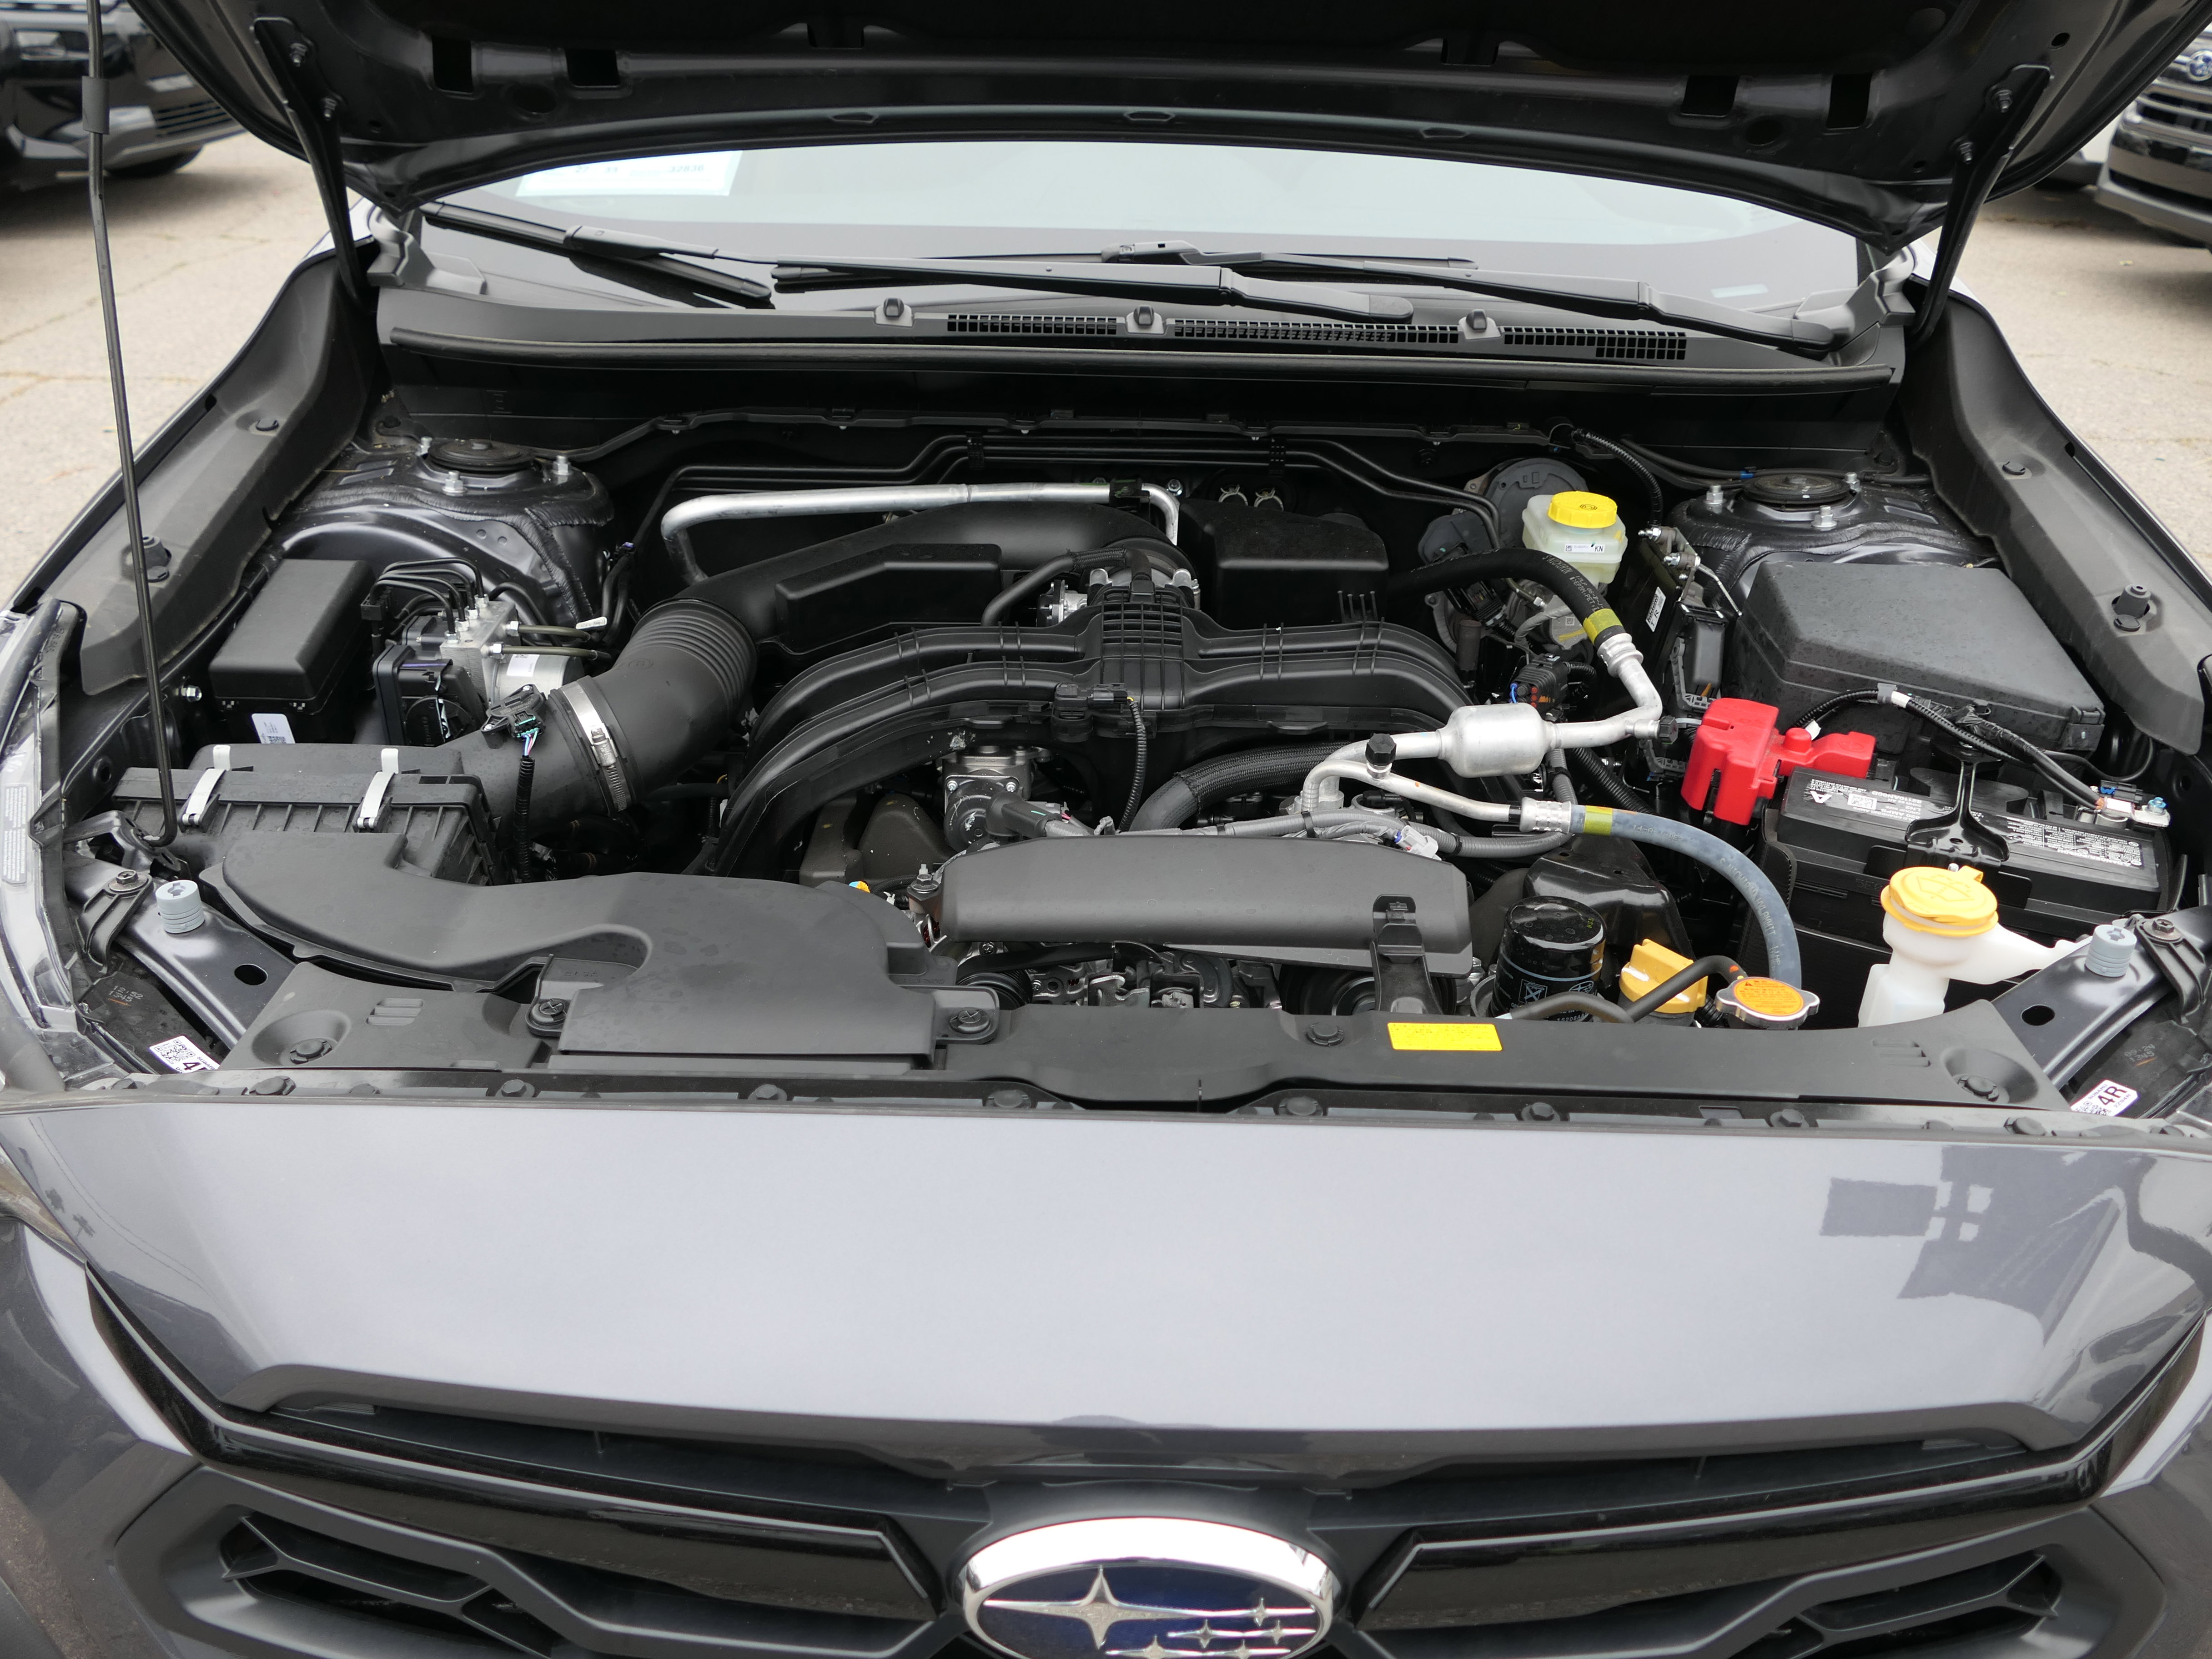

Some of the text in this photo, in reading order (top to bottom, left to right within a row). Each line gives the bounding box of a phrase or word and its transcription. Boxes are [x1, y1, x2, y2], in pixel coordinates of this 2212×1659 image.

[1810, 790, 1832, 804] A
[1870, 809, 1902, 819] CRANKING
[1880, 808, 1905, 816] AMPS
[2088, 1084, 2107, 1100] SUBARU
[2098, 1086, 2127, 1106] 4R
